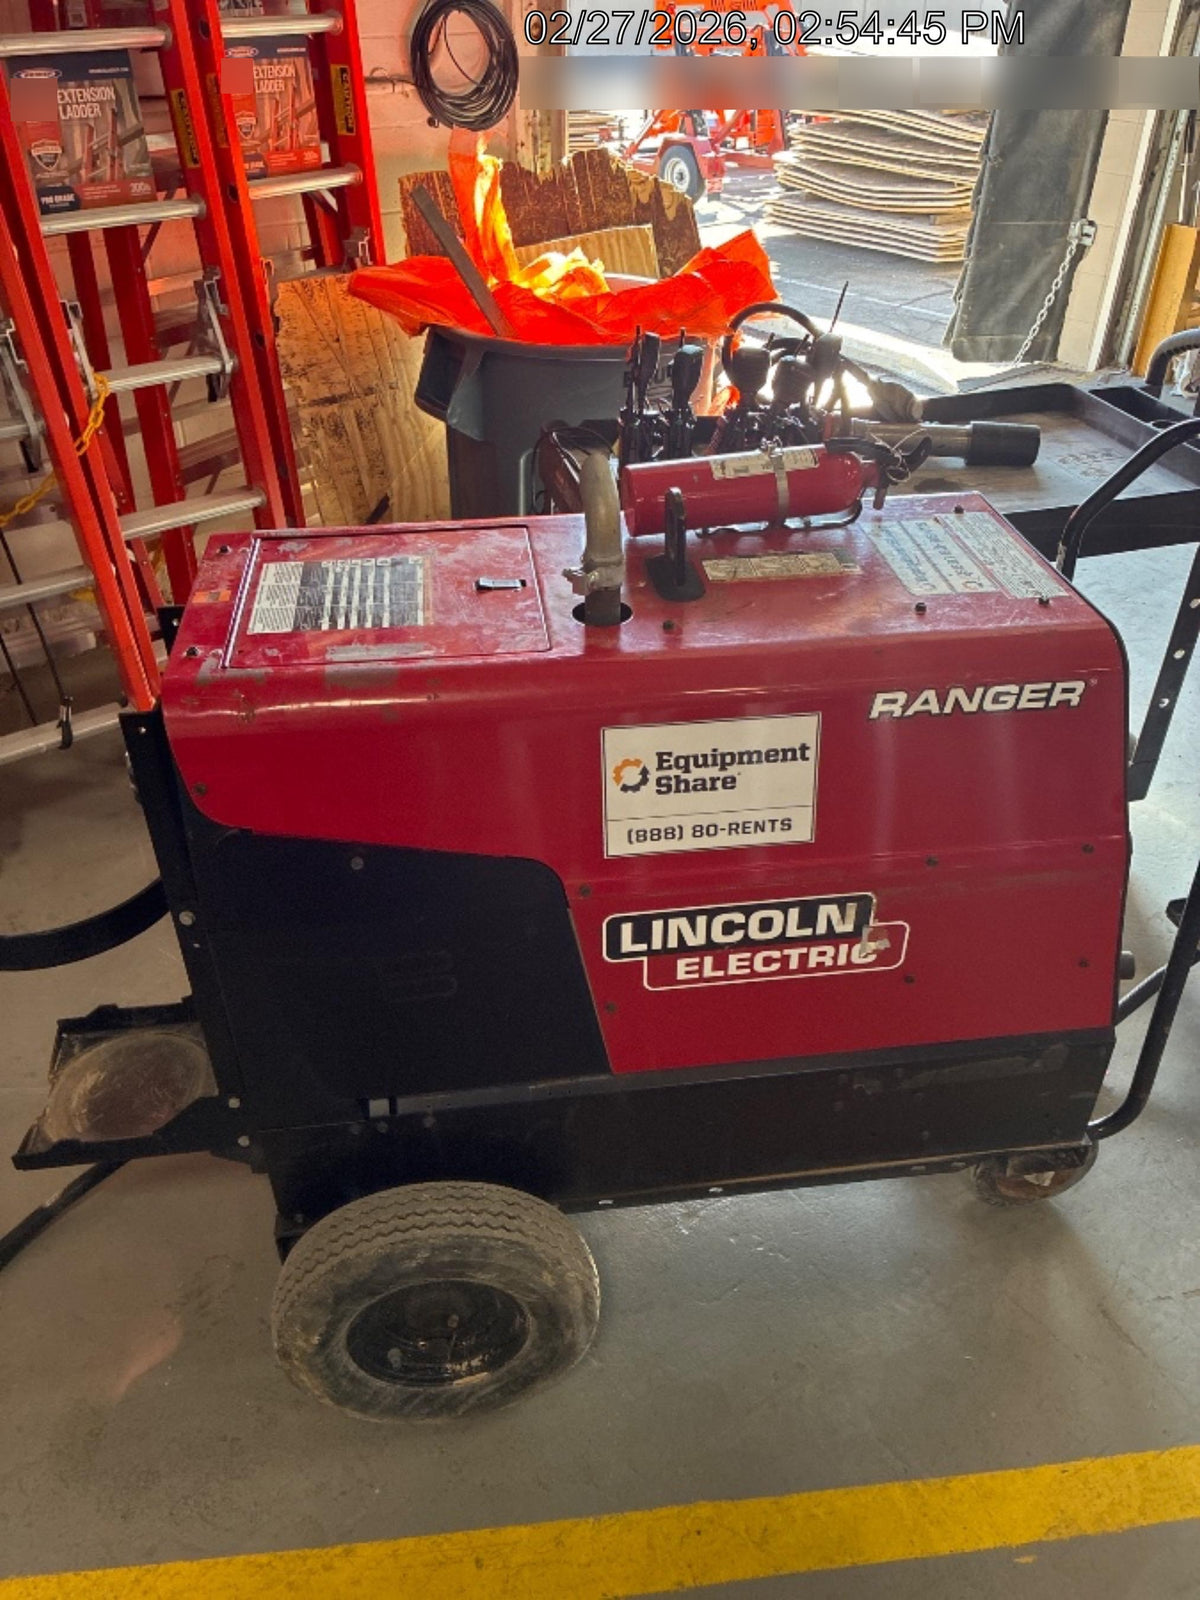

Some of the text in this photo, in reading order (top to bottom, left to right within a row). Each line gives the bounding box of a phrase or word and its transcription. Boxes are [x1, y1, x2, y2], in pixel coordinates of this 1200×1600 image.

[253, 64, 296, 79] EXTENSION
[56, 85, 116, 104] EXTENSION
[256, 79, 285, 93] LADDER
[59, 102, 102, 120] LADDER
[867, 680, 1087, 720] RANGER
[655, 743, 811, 772] Equipment
[655, 775, 738, 795] Share
[627, 817, 793, 846] (888) 80-RENTS
[619, 902, 858, 954] LINCOLN
[675, 942, 879, 981] ELECTRIC
